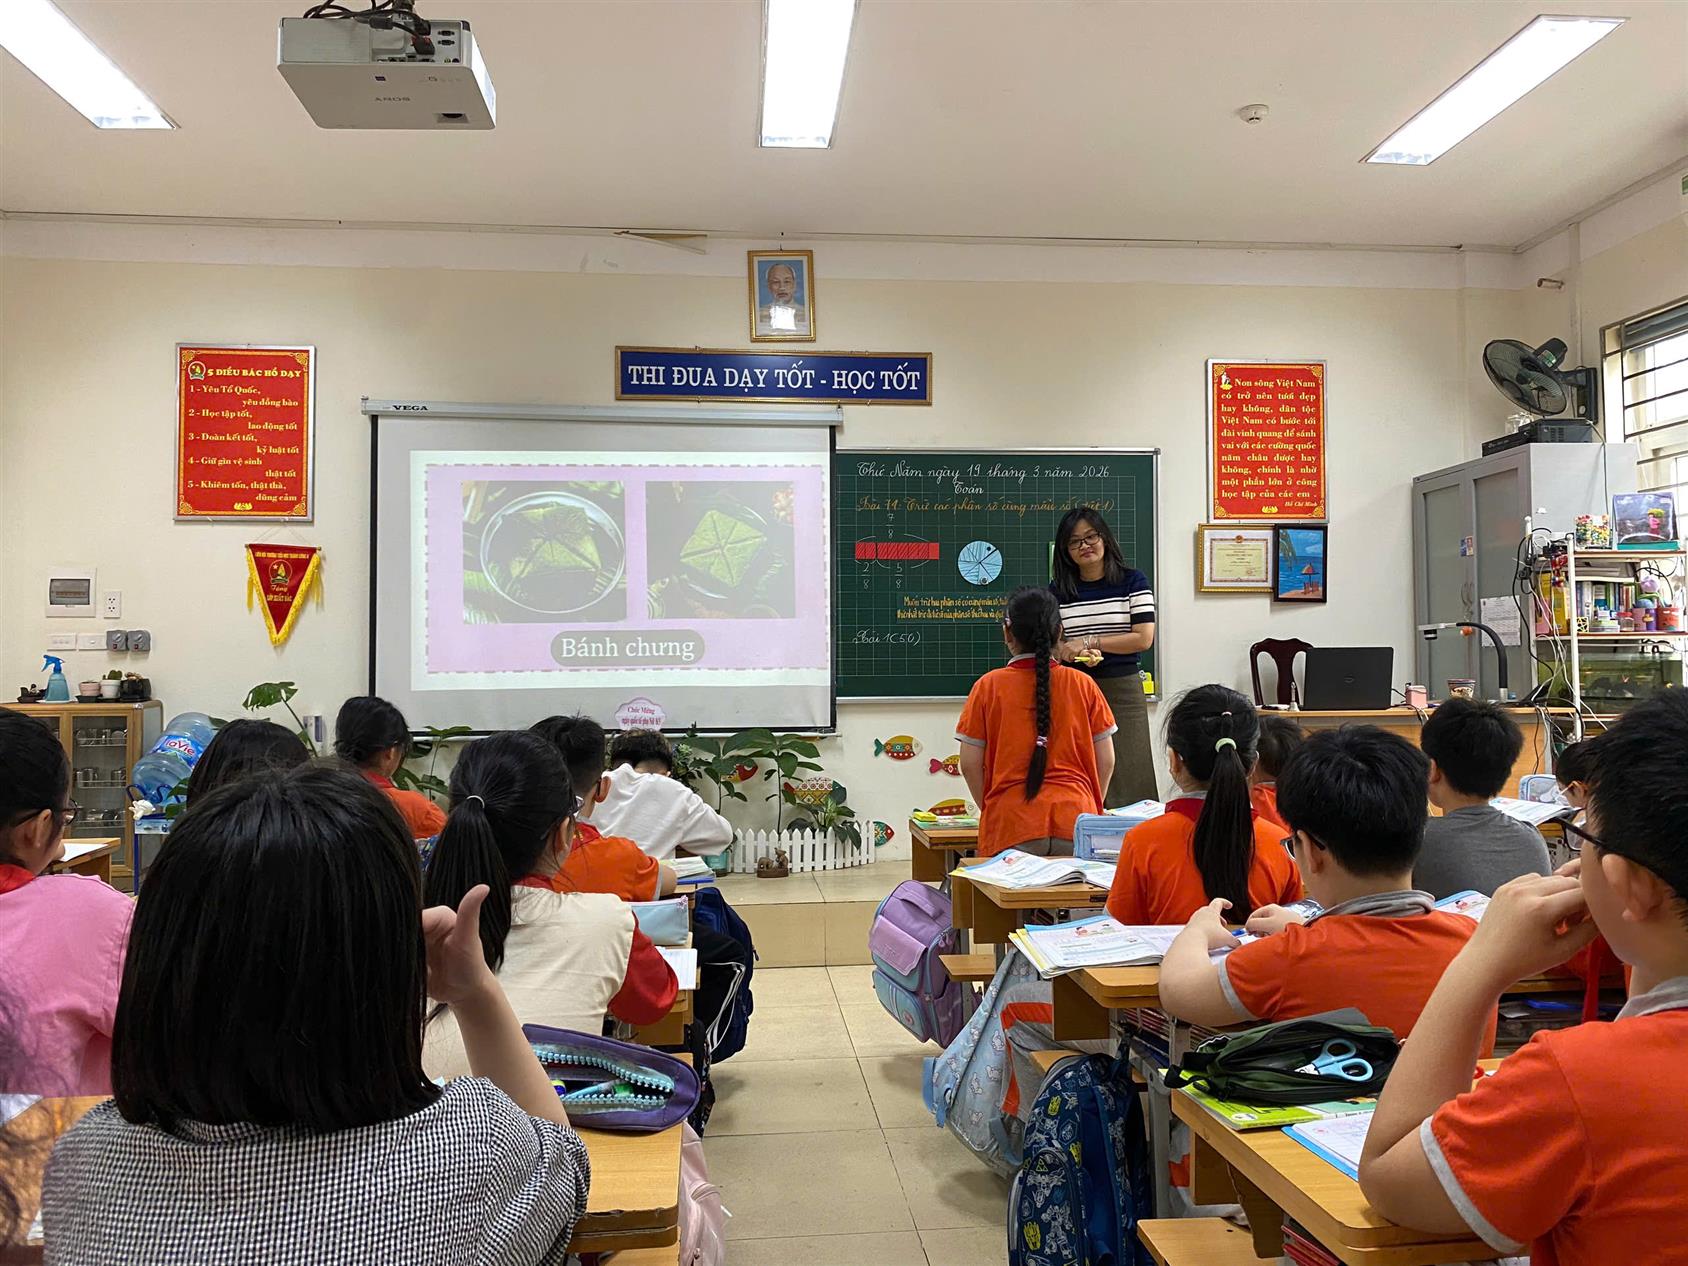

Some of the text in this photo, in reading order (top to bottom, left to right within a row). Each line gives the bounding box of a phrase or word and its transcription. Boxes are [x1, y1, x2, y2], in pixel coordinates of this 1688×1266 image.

[242, 368, 262, 376] BÁC
[281, 370, 302, 378] DẠY
[629, 365, 665, 385] THI
[672, 366, 717, 386] ĐUA
[724, 368, 768, 392] DẠY
[775, 360, 814, 388] TỐT
[832, 370, 875, 394] HỌC
[880, 362, 920, 390] TỐT
[1277, 379, 1293, 388] Việt
[220, 384, 233, 393] Tổ
[235, 385, 260, 395] Quốc,
[242, 399, 258, 407] yêu
[1221, 405, 1236, 413] hay
[1243, 405, 1273, 413] không,
[1302, 405, 1316, 413] tộc
[202, 410, 219, 418] Học
[221, 410, 236, 418] tập
[1221, 416, 1239, 424] Việt
[1280, 416, 1300, 424] bước
[261, 422, 283, 431] động
[1257, 431, 1282, 439] quang
[1268, 441, 1294, 450] cường
[1296, 441, 1316, 451] quốc
[218, 458, 231, 467] gìn
[233, 458, 242, 466] vệ
[1301, 454, 1316, 462] hay
[265, 470, 283, 478] thật
[857, 460, 1110, 484] Thứ Năm ngày 19 tháng 3 năm 2026
[1221, 466, 1251, 474] không,
[231, 482, 248, 490] tốn,
[251, 482, 268, 490] thật
[270, 482, 286, 490] thà,
[1221, 478, 1238, 487] một
[1243, 477, 1264, 487] phần
[1296, 478, 1317, 487] công
[954, 480, 984, 494] Toán
[256, 493, 277, 502] dũng
[1222, 490, 1238, 498] học
[1242, 491, 1256, 499] tập
[1260, 490, 1275, 498] của
[888, 529, 893, 539] 8
[863, 562, 903, 572] 2 5
[864, 579, 901, 589] 8 8
[853, 629, 880, 644] Bài
[562, 637, 695, 661] Bánh chưng
